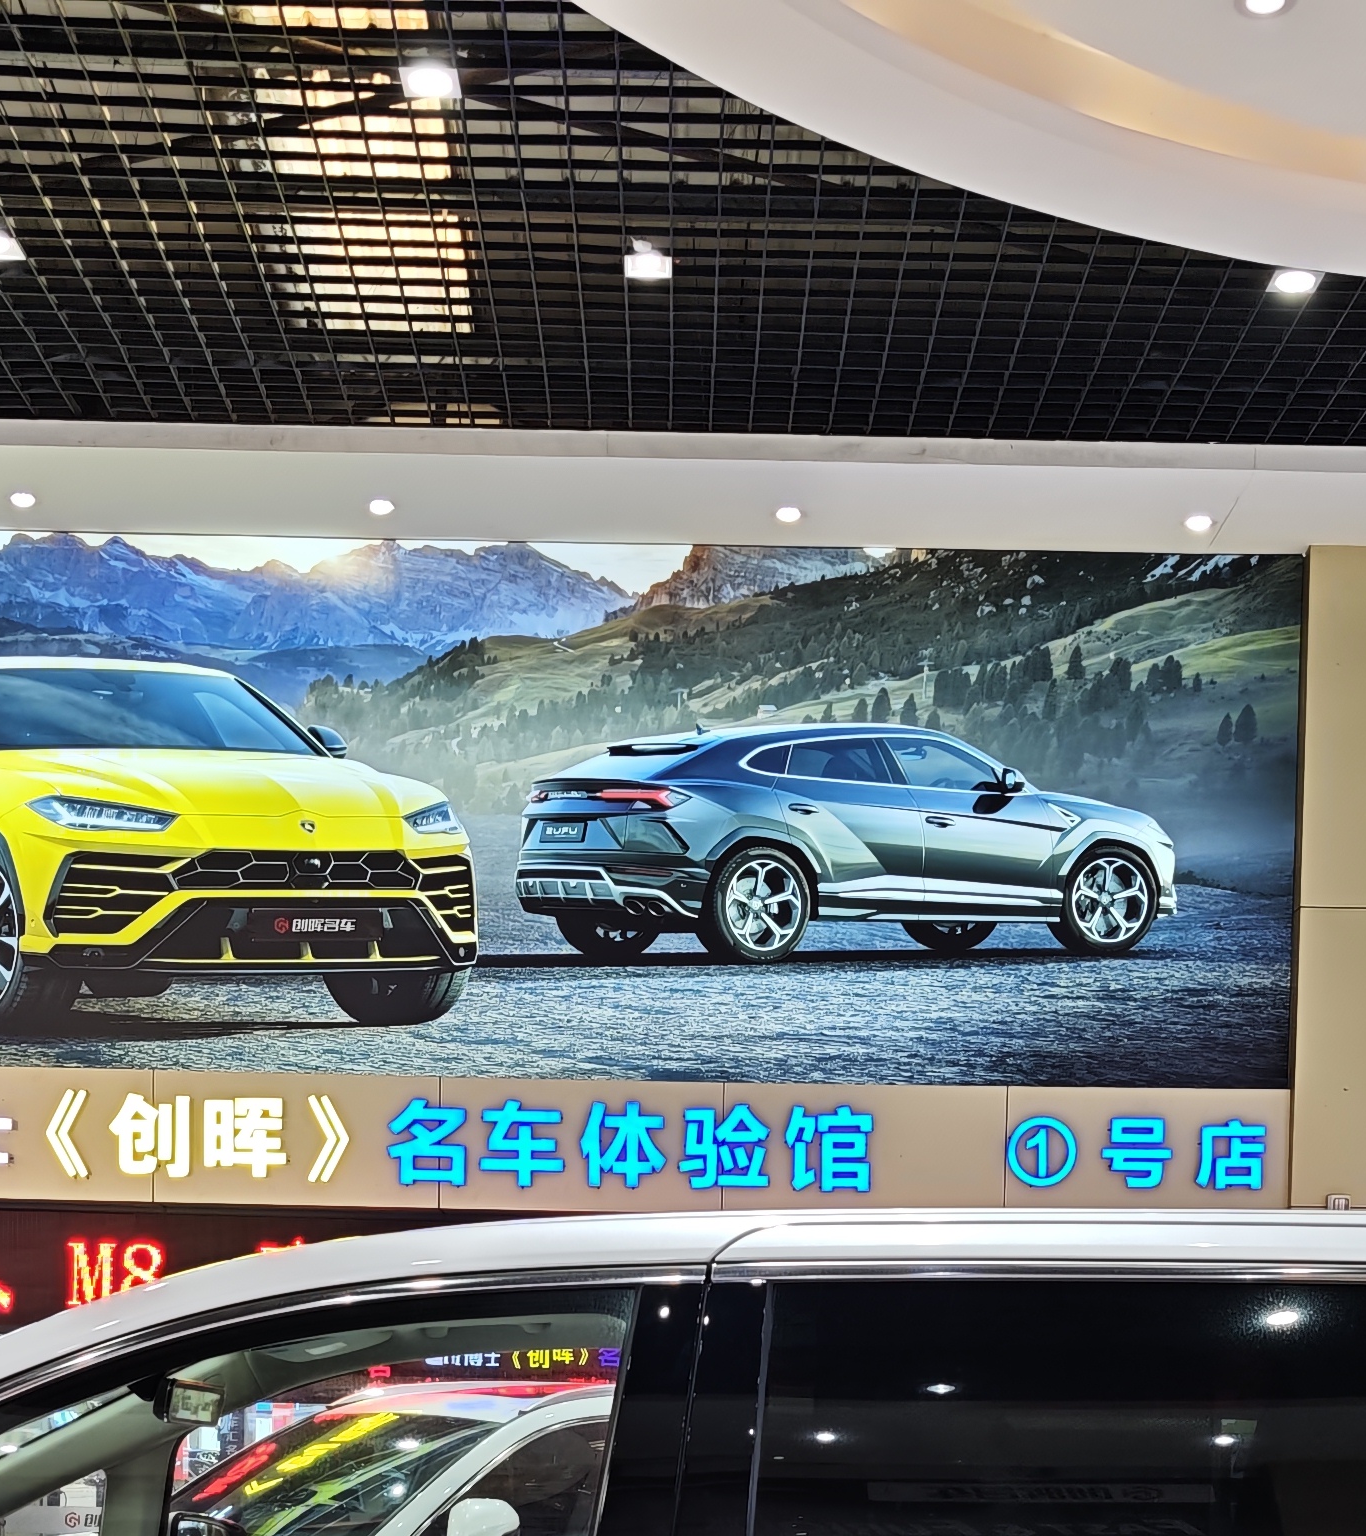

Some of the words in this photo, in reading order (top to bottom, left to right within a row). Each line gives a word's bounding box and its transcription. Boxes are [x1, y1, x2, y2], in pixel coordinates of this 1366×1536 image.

[292, 918, 357, 933] 创晖名车
[46, 1089, 351, 1183] 《创晖》
[387, 1098, 874, 1193] 名车体验馆
